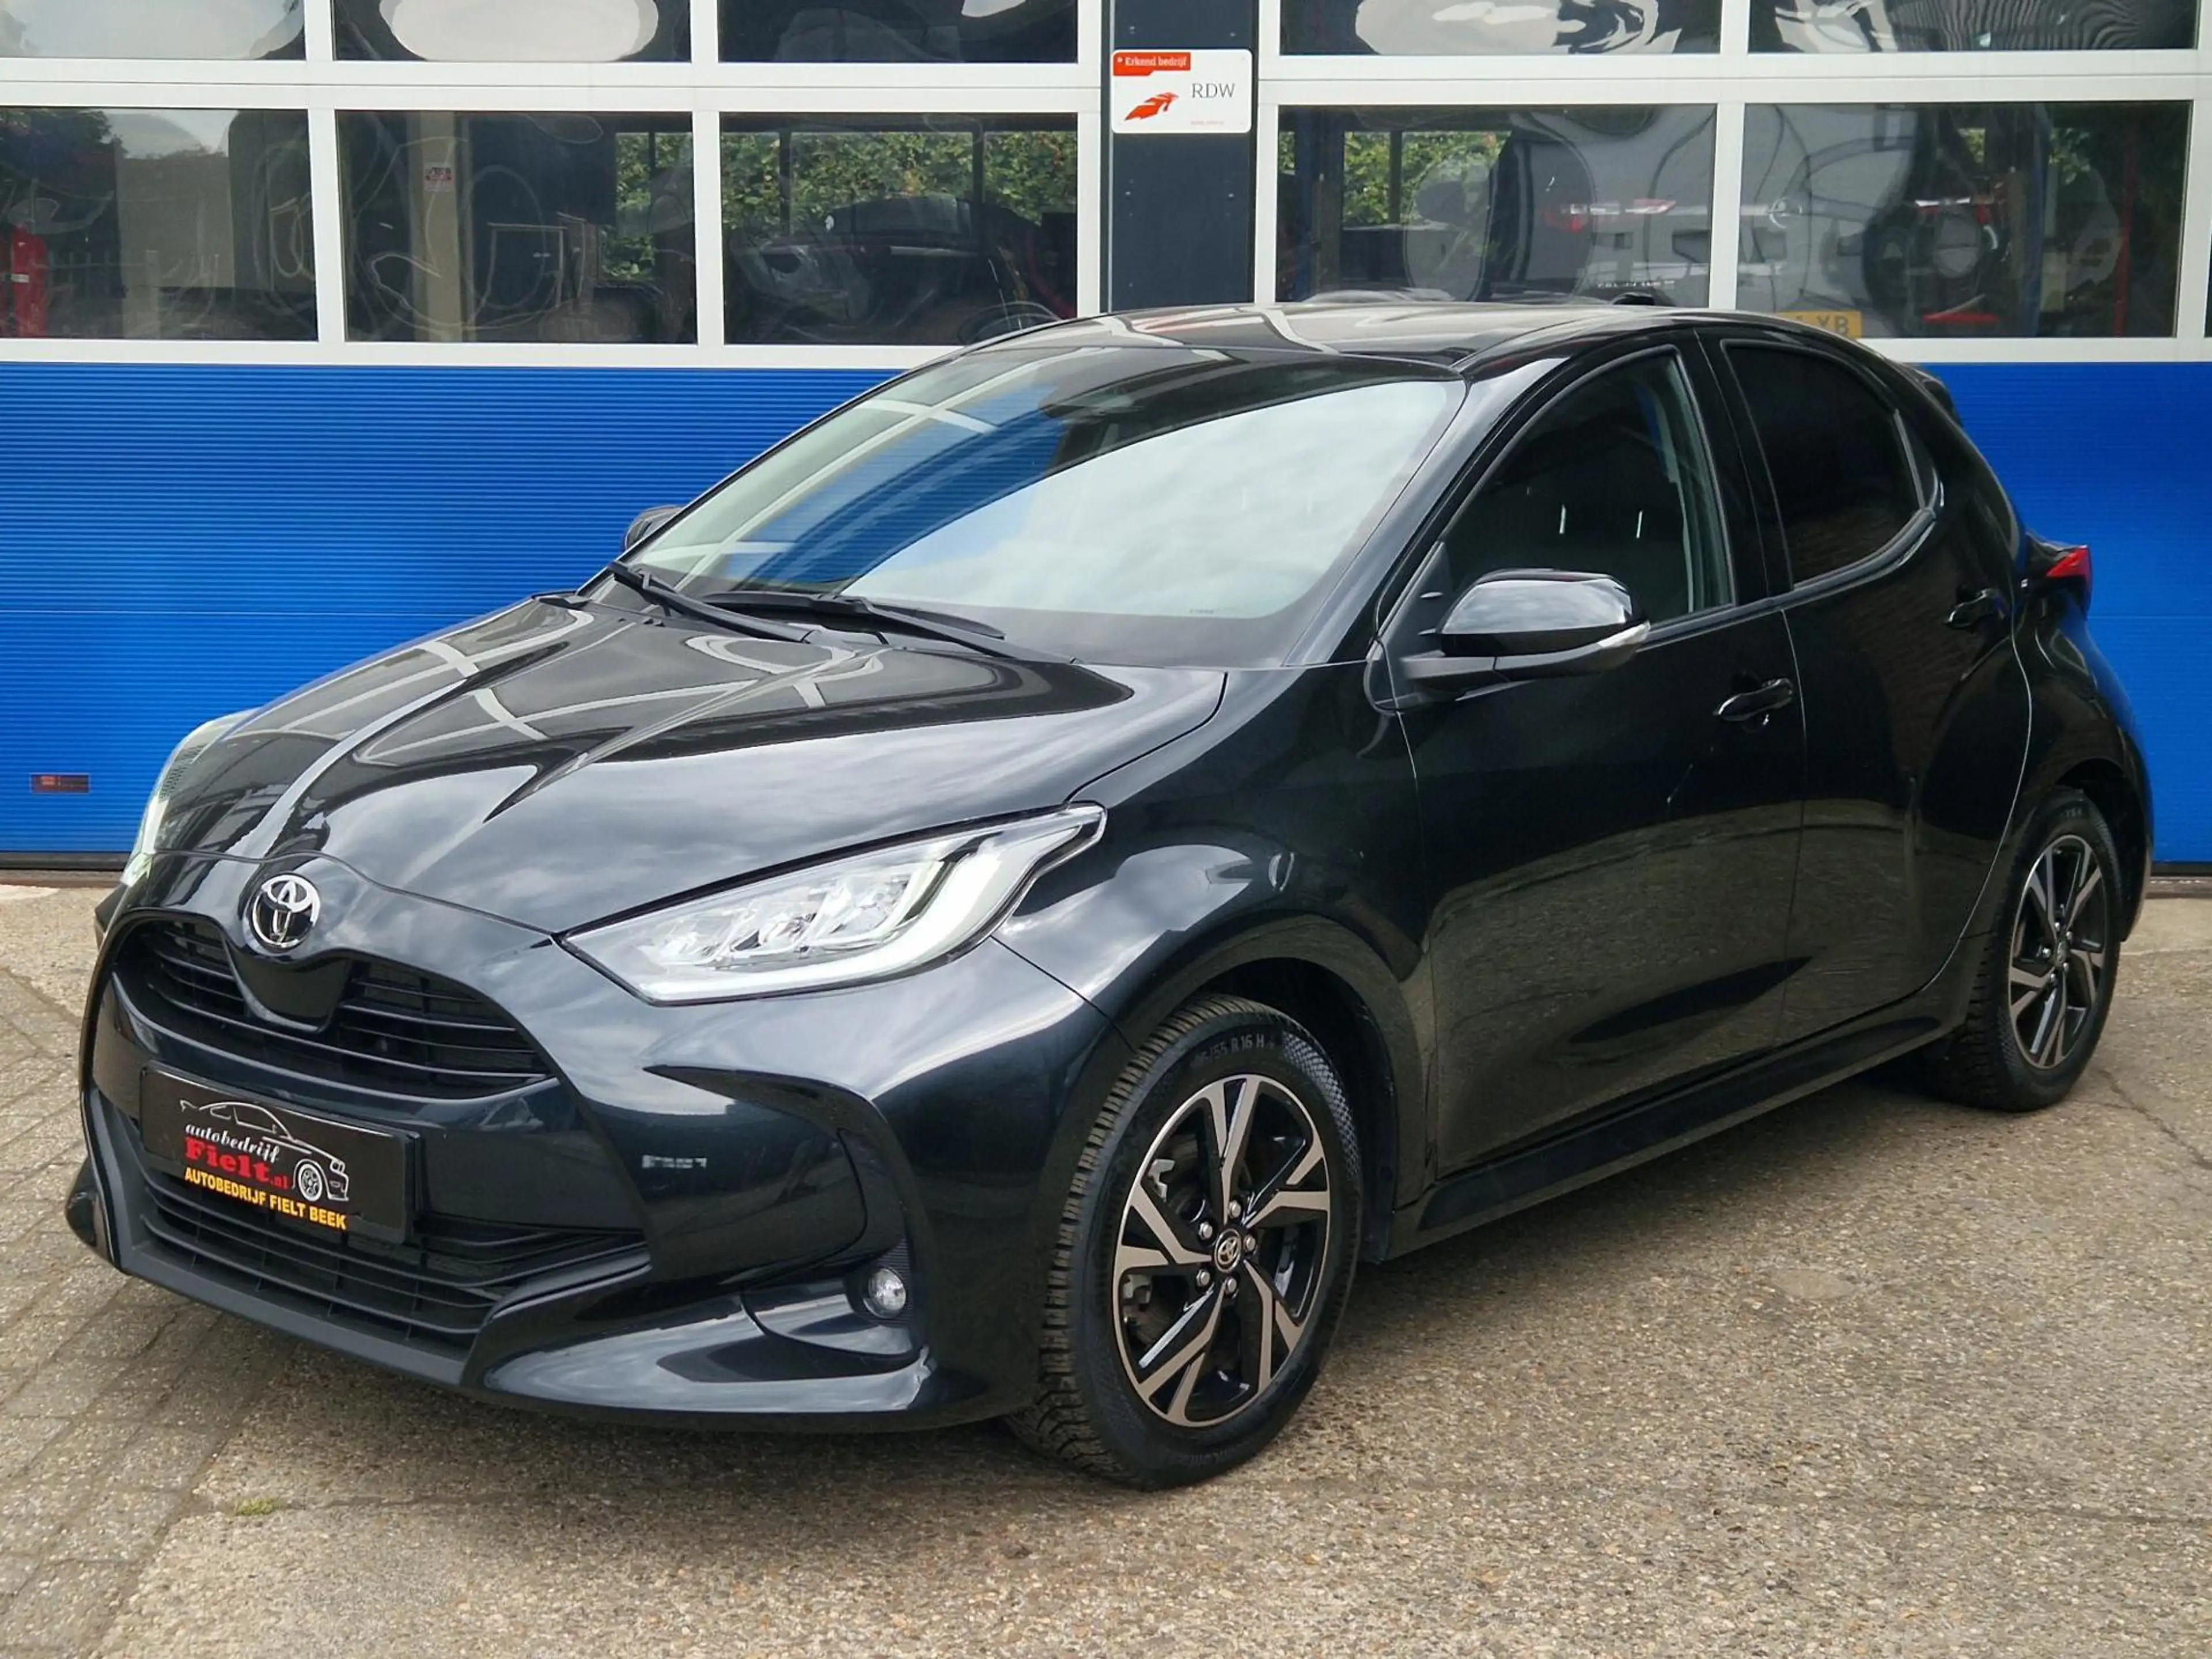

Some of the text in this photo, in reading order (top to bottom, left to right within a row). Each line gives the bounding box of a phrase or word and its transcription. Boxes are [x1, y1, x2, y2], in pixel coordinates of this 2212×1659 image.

[1124, 56, 1187, 68] Erkend bedrijf
[1191, 82, 1235, 99] RDW
[185, 1124, 280, 1163] autobedrijf
[184, 1166, 347, 1230] AUTOBEDRIJF FIELT BEEK
